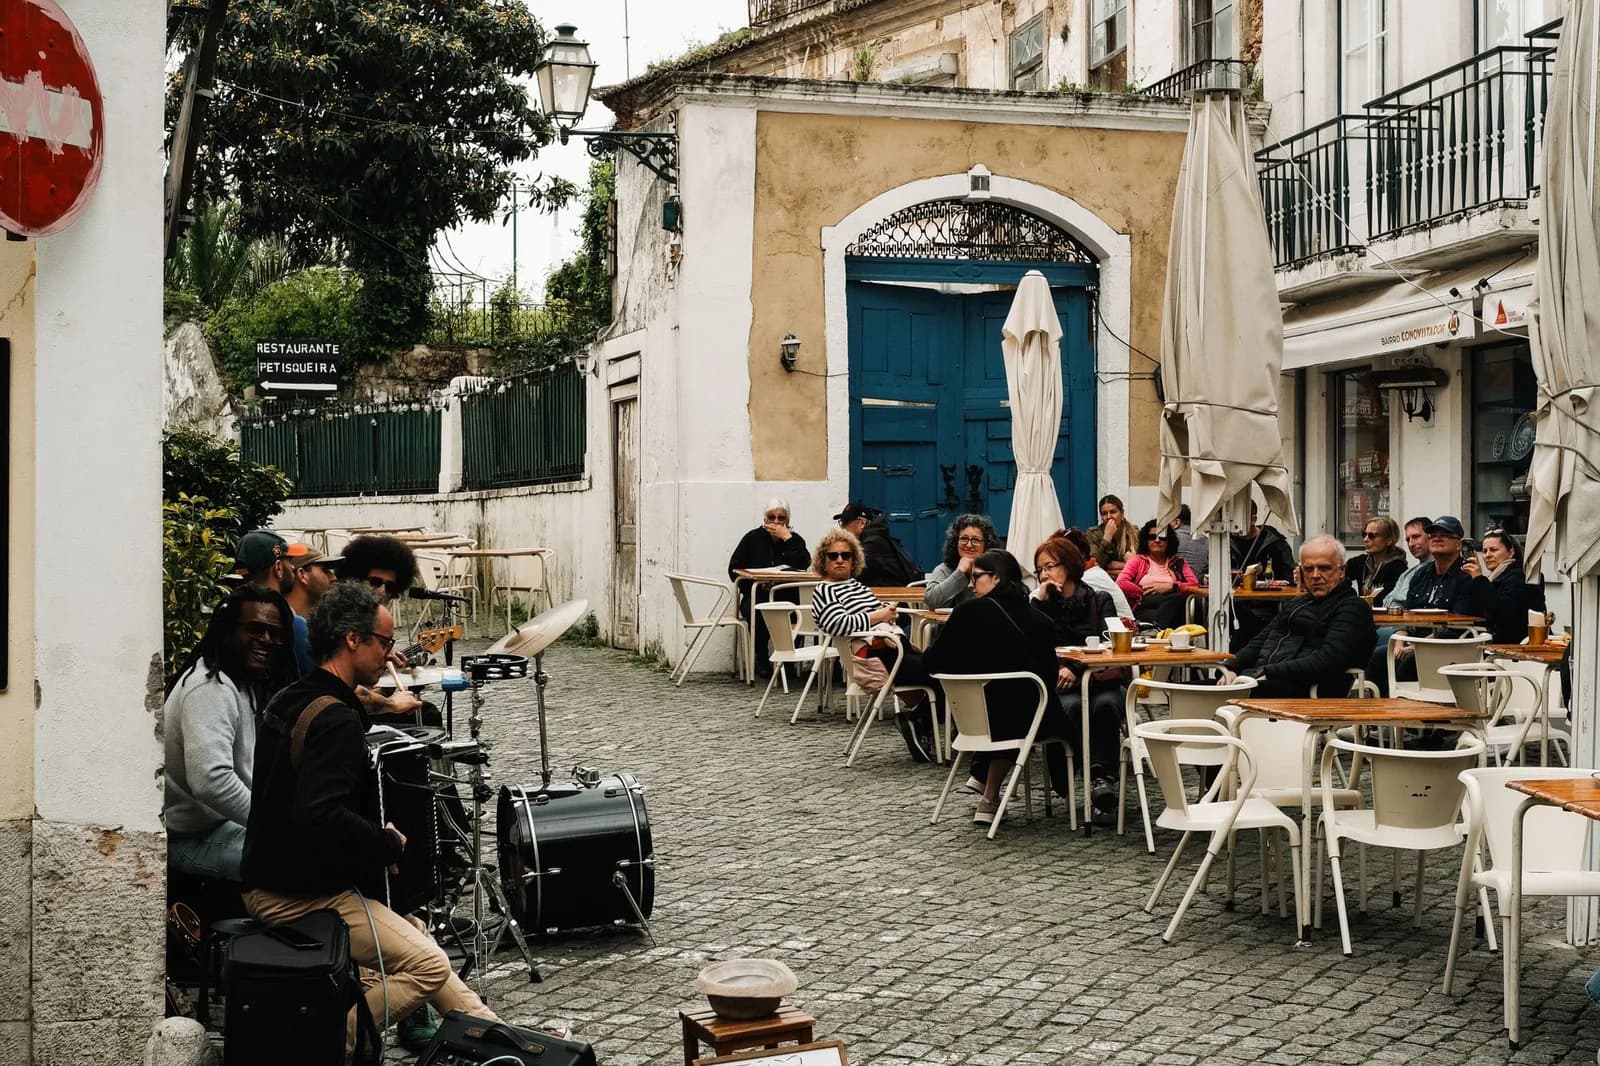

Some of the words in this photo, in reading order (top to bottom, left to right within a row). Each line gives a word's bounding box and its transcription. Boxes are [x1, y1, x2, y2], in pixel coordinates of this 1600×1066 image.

[1381, 335, 1400, 346] BAIRRO
[257, 343, 340, 354] RESTAURANTE
[260, 362, 337, 373] PETISQUEIRA
